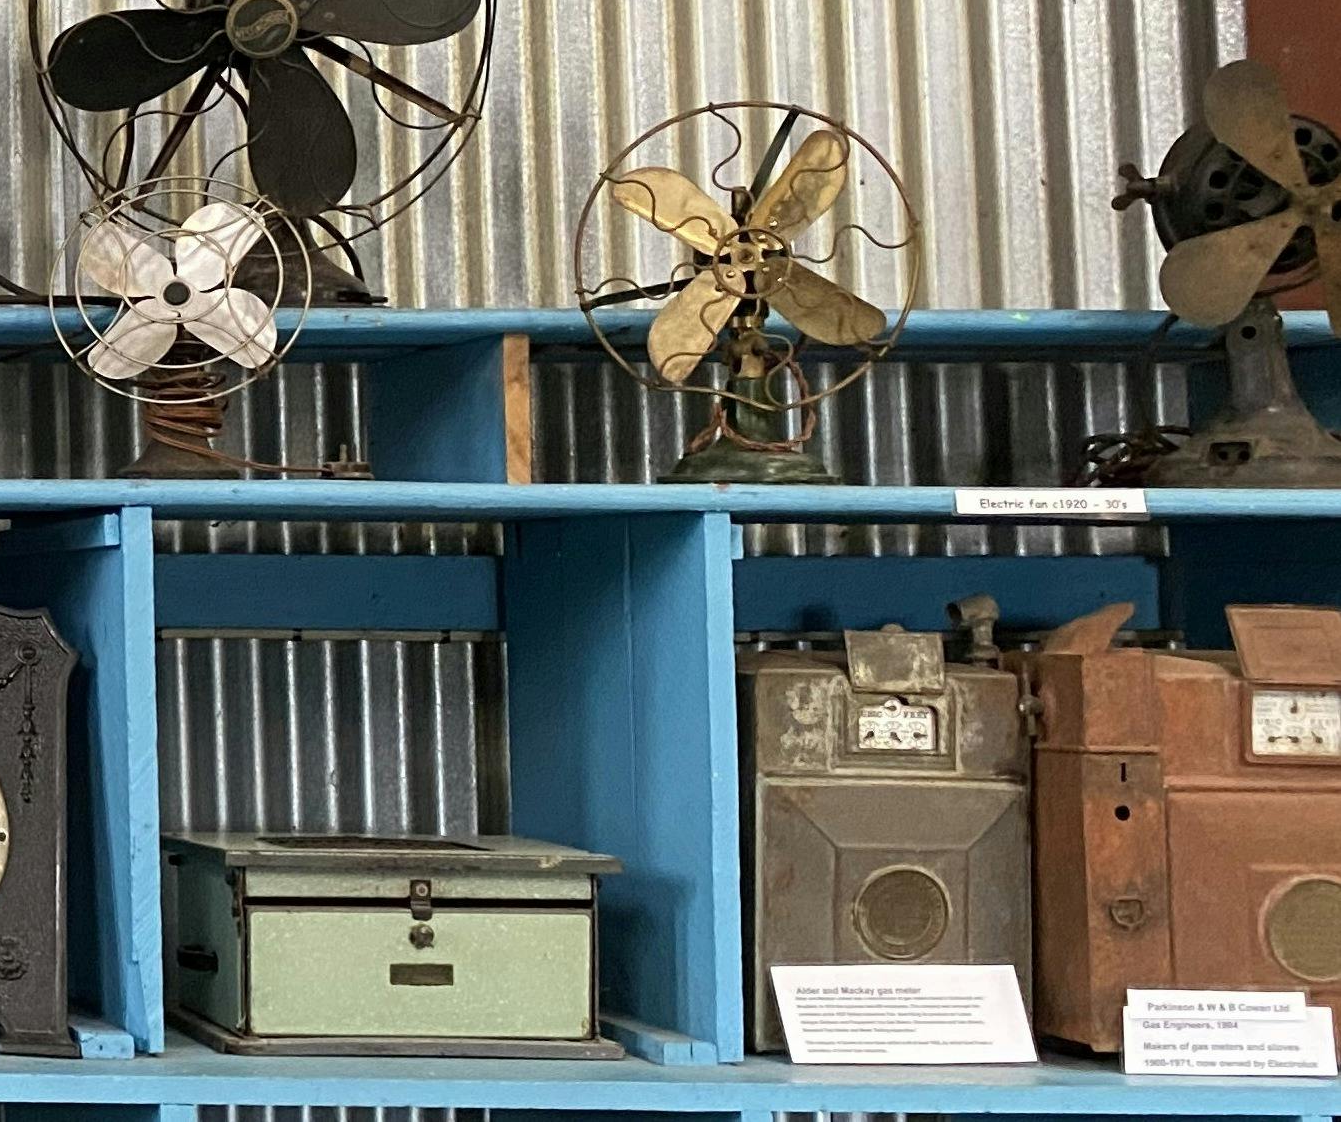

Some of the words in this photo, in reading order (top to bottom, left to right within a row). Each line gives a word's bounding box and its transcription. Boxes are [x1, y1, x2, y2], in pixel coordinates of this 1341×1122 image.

[980, 498, 1024, 509] Electric
[1029, 498, 1048, 509] fan
[1053, 499, 1088, 509] c1920
[823, 986, 839, 995] and
[877, 988, 893, 997] gas
[1147, 1003, 1194, 1011] Parkinson
[1142, 1021, 1160, 1029] Gas
[1163, 1021, 1214, 1030] Engineers,
[1143, 1042, 1177, 1051] Makers
[1180, 1042, 1189, 1051] of
[1192, 1044, 1209, 1053] gas
[1247, 1043, 1264, 1051] and
